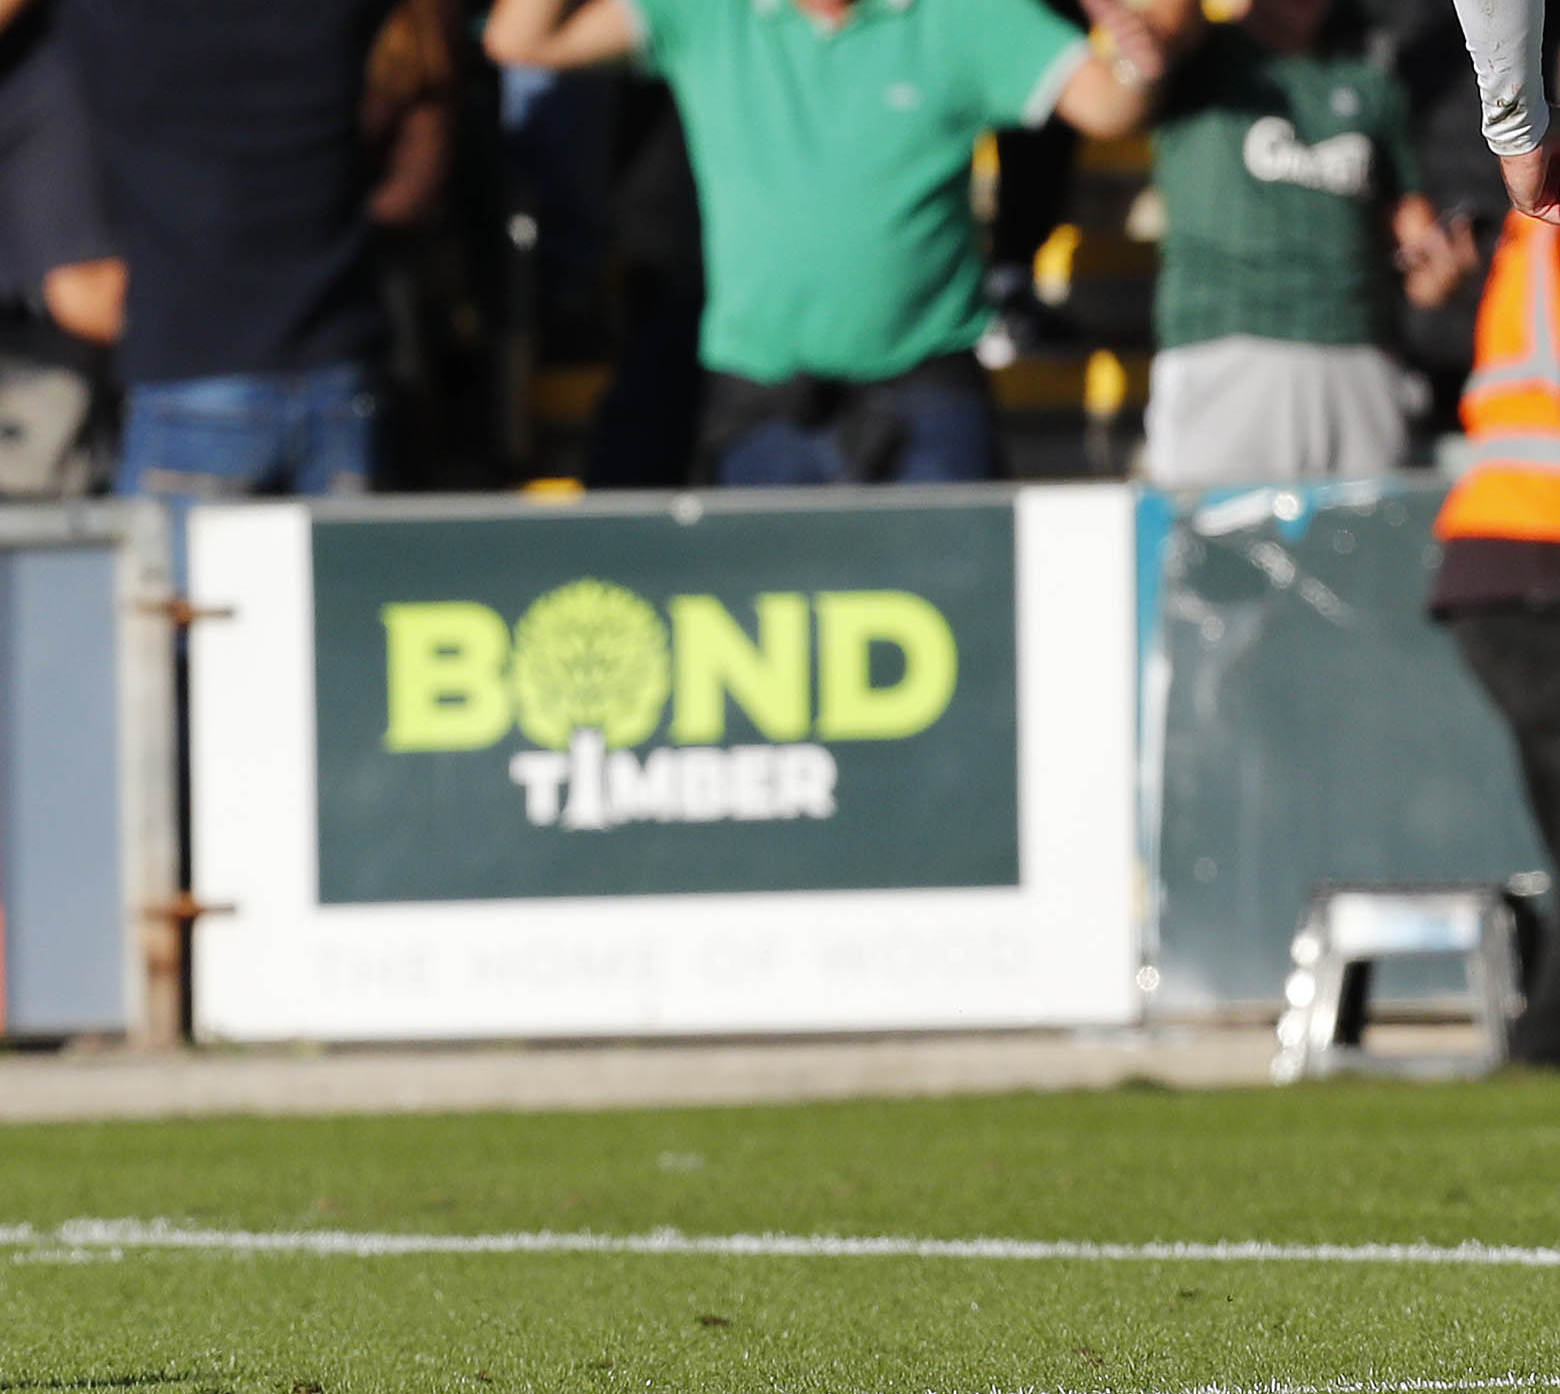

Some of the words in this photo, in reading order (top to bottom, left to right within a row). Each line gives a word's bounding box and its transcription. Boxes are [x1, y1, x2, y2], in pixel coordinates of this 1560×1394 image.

[382, 579, 958, 752] BOND
[509, 726, 838, 830] TIMBER
[314, 937, 434, 996] THE
[472, 934, 662, 992] HOME
[695, 928, 784, 989] OF
[817, 925, 1034, 986] WOOD
